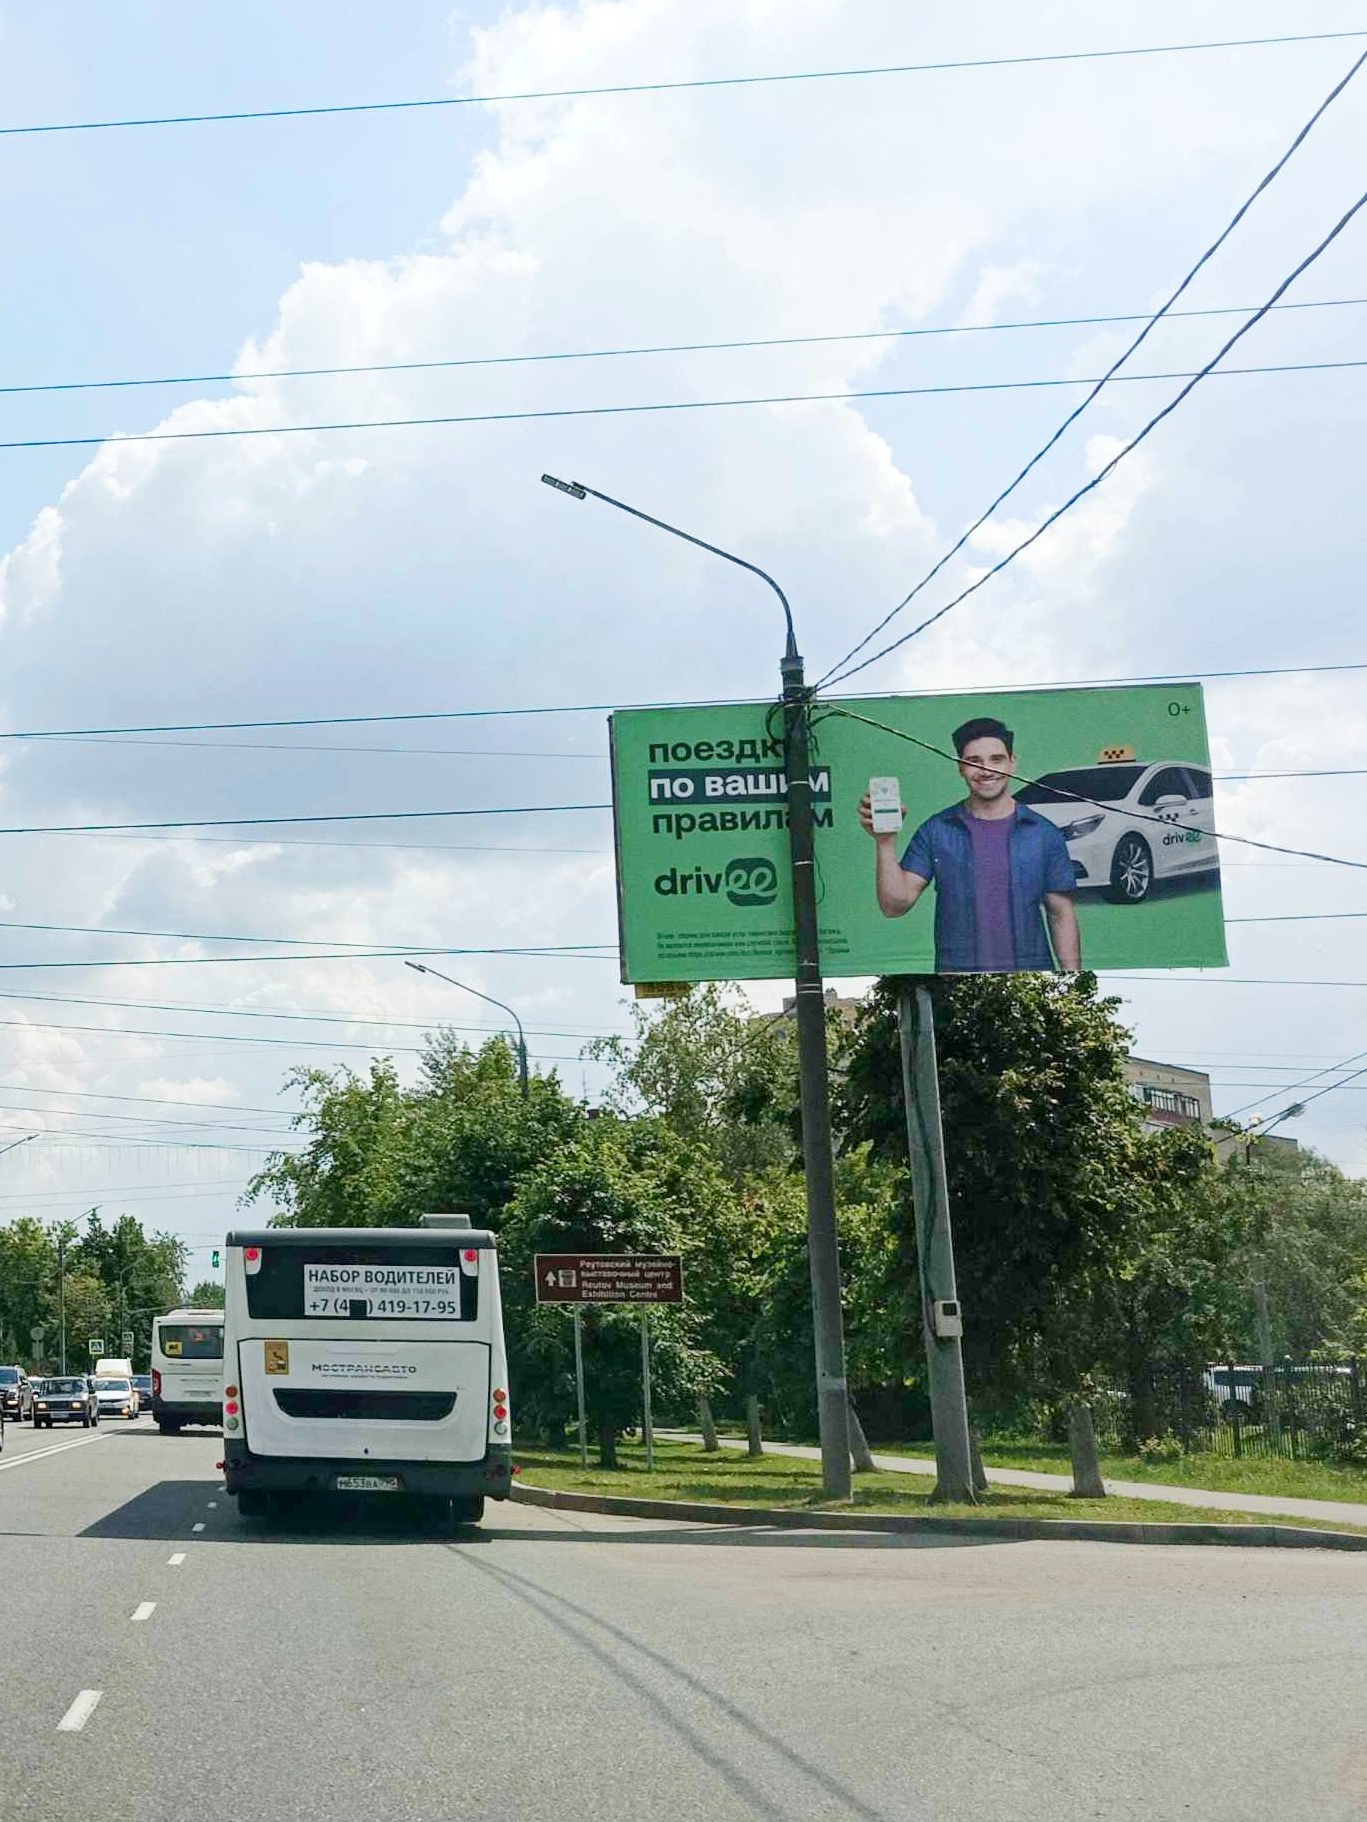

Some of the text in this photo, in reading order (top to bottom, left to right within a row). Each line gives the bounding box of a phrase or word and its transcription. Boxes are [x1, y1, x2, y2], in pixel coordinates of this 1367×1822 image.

[649, 738, 790, 763] поездк
[650, 777, 695, 799] по
[653, 808, 834, 840] правилм
[309, 1269, 455, 1286] НАБОР ВОДИТЕЛЕЙ
[309, 1298, 456, 1314] +7 (4) 419-17-95
